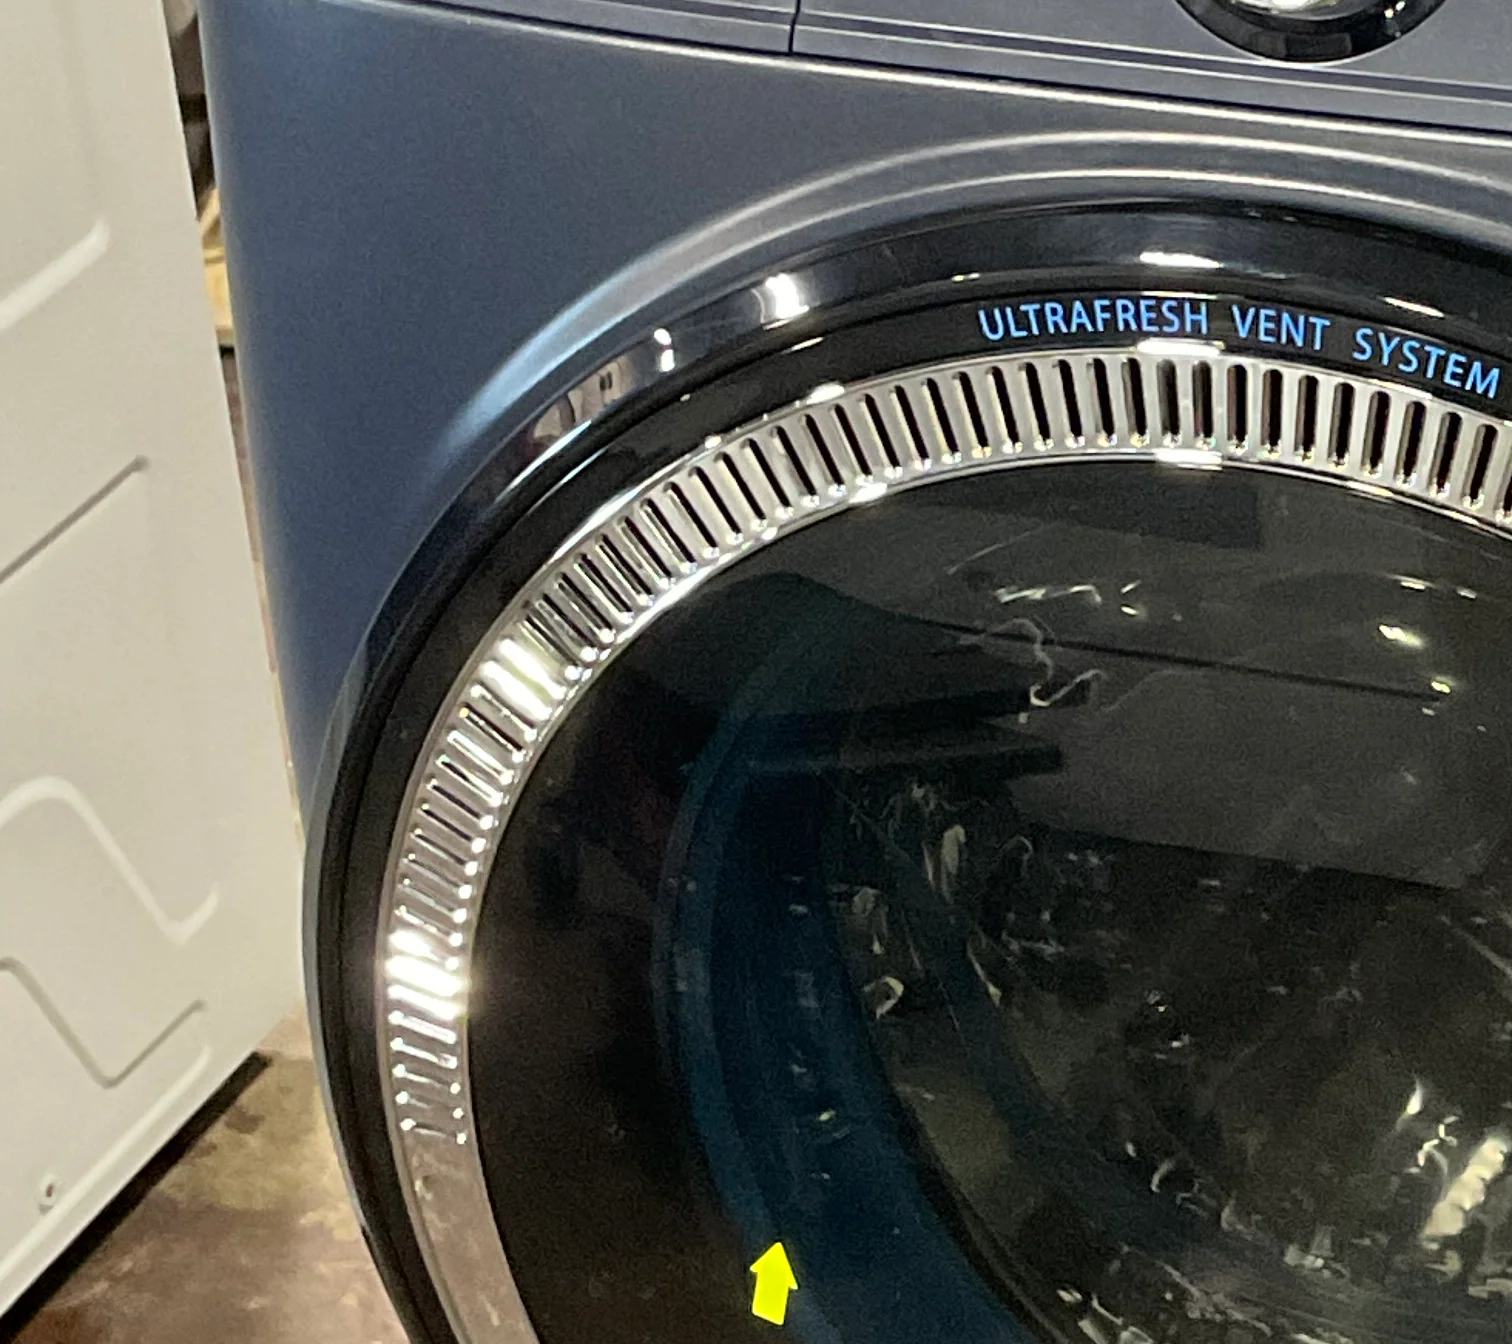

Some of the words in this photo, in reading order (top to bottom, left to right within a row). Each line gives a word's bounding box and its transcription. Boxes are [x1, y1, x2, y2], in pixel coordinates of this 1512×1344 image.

[978, 296, 1209, 342] ULTRAFRESH
[1231, 304, 1332, 352] VENT
[1352, 327, 1502, 400] SYSTEM
